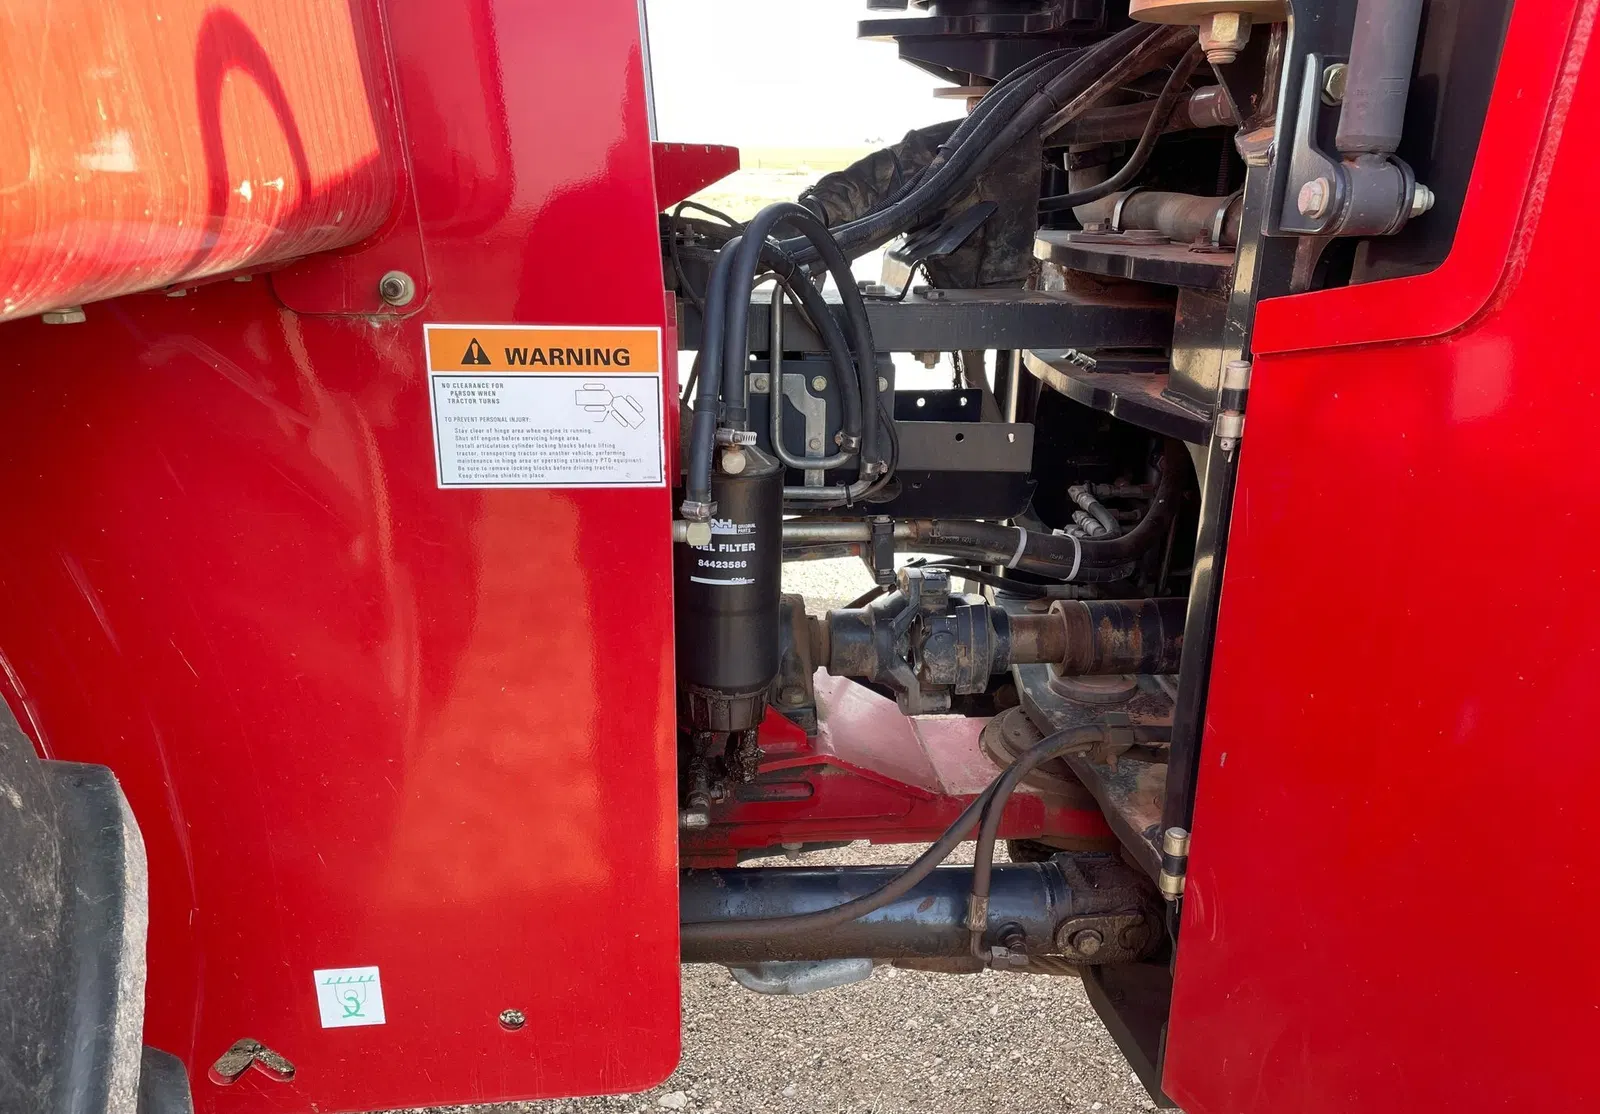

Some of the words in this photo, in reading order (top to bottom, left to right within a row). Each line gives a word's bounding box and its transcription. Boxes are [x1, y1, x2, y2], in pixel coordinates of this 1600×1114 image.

[505, 348, 630, 366] WARNING
[719, 543, 755, 552] FILTER
[698, 559, 747, 568] 84423586
